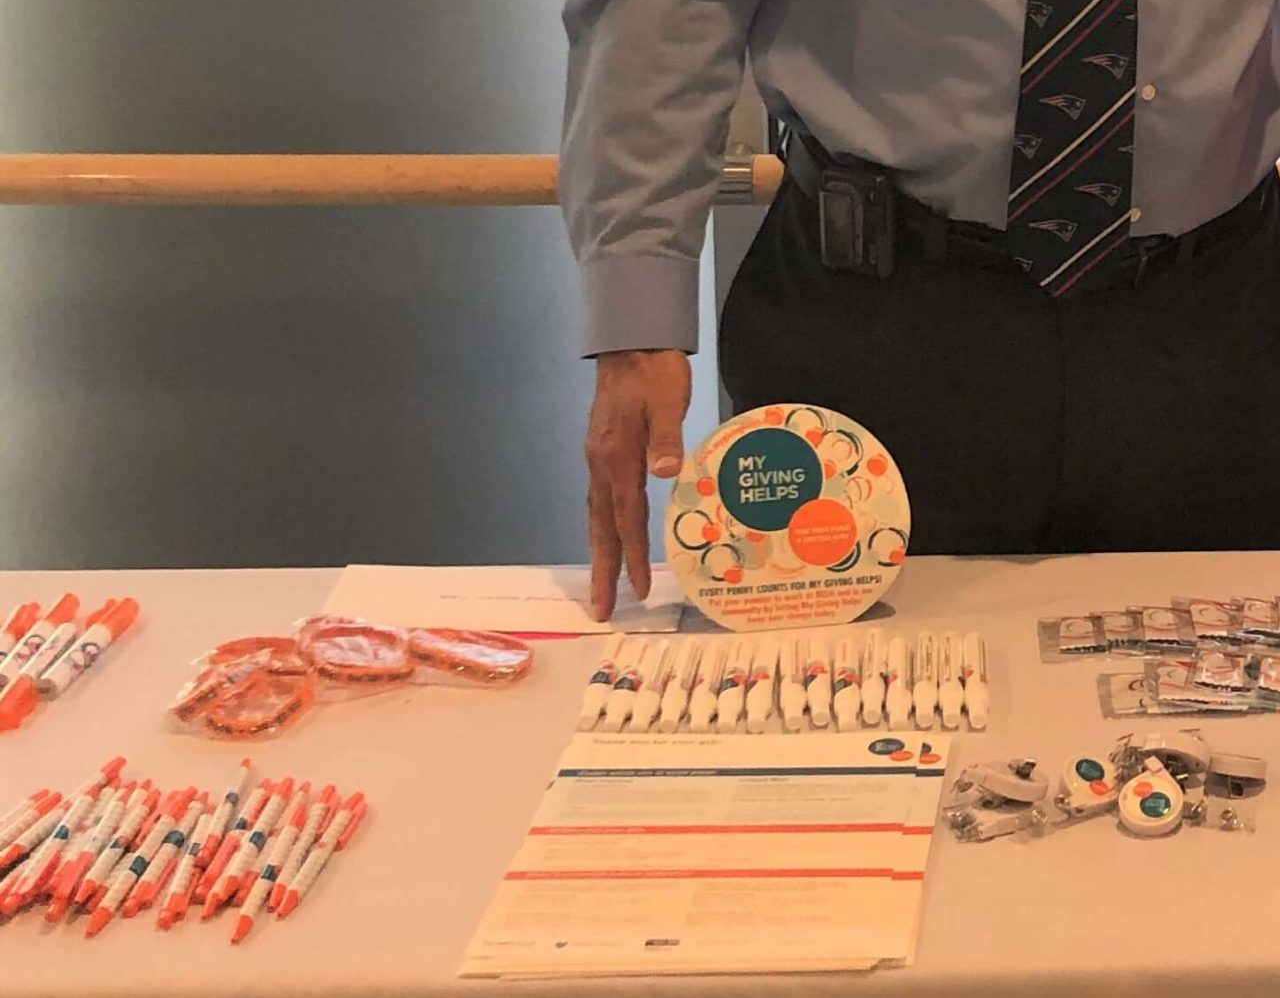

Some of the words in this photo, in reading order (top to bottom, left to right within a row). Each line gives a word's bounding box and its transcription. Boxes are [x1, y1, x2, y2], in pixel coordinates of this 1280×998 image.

[738, 456, 767, 471] MY
[739, 468, 806, 487] GIVING
[740, 484, 800, 504] HELPS
[699, 587, 724, 598] EVERY
[726, 586, 754, 596] PENNY
[756, 583, 788, 594] COUNTS
[790, 582, 807, 591] FOR
[808, 580, 822, 590] MY
[824, 577, 854, 588] GIVING
